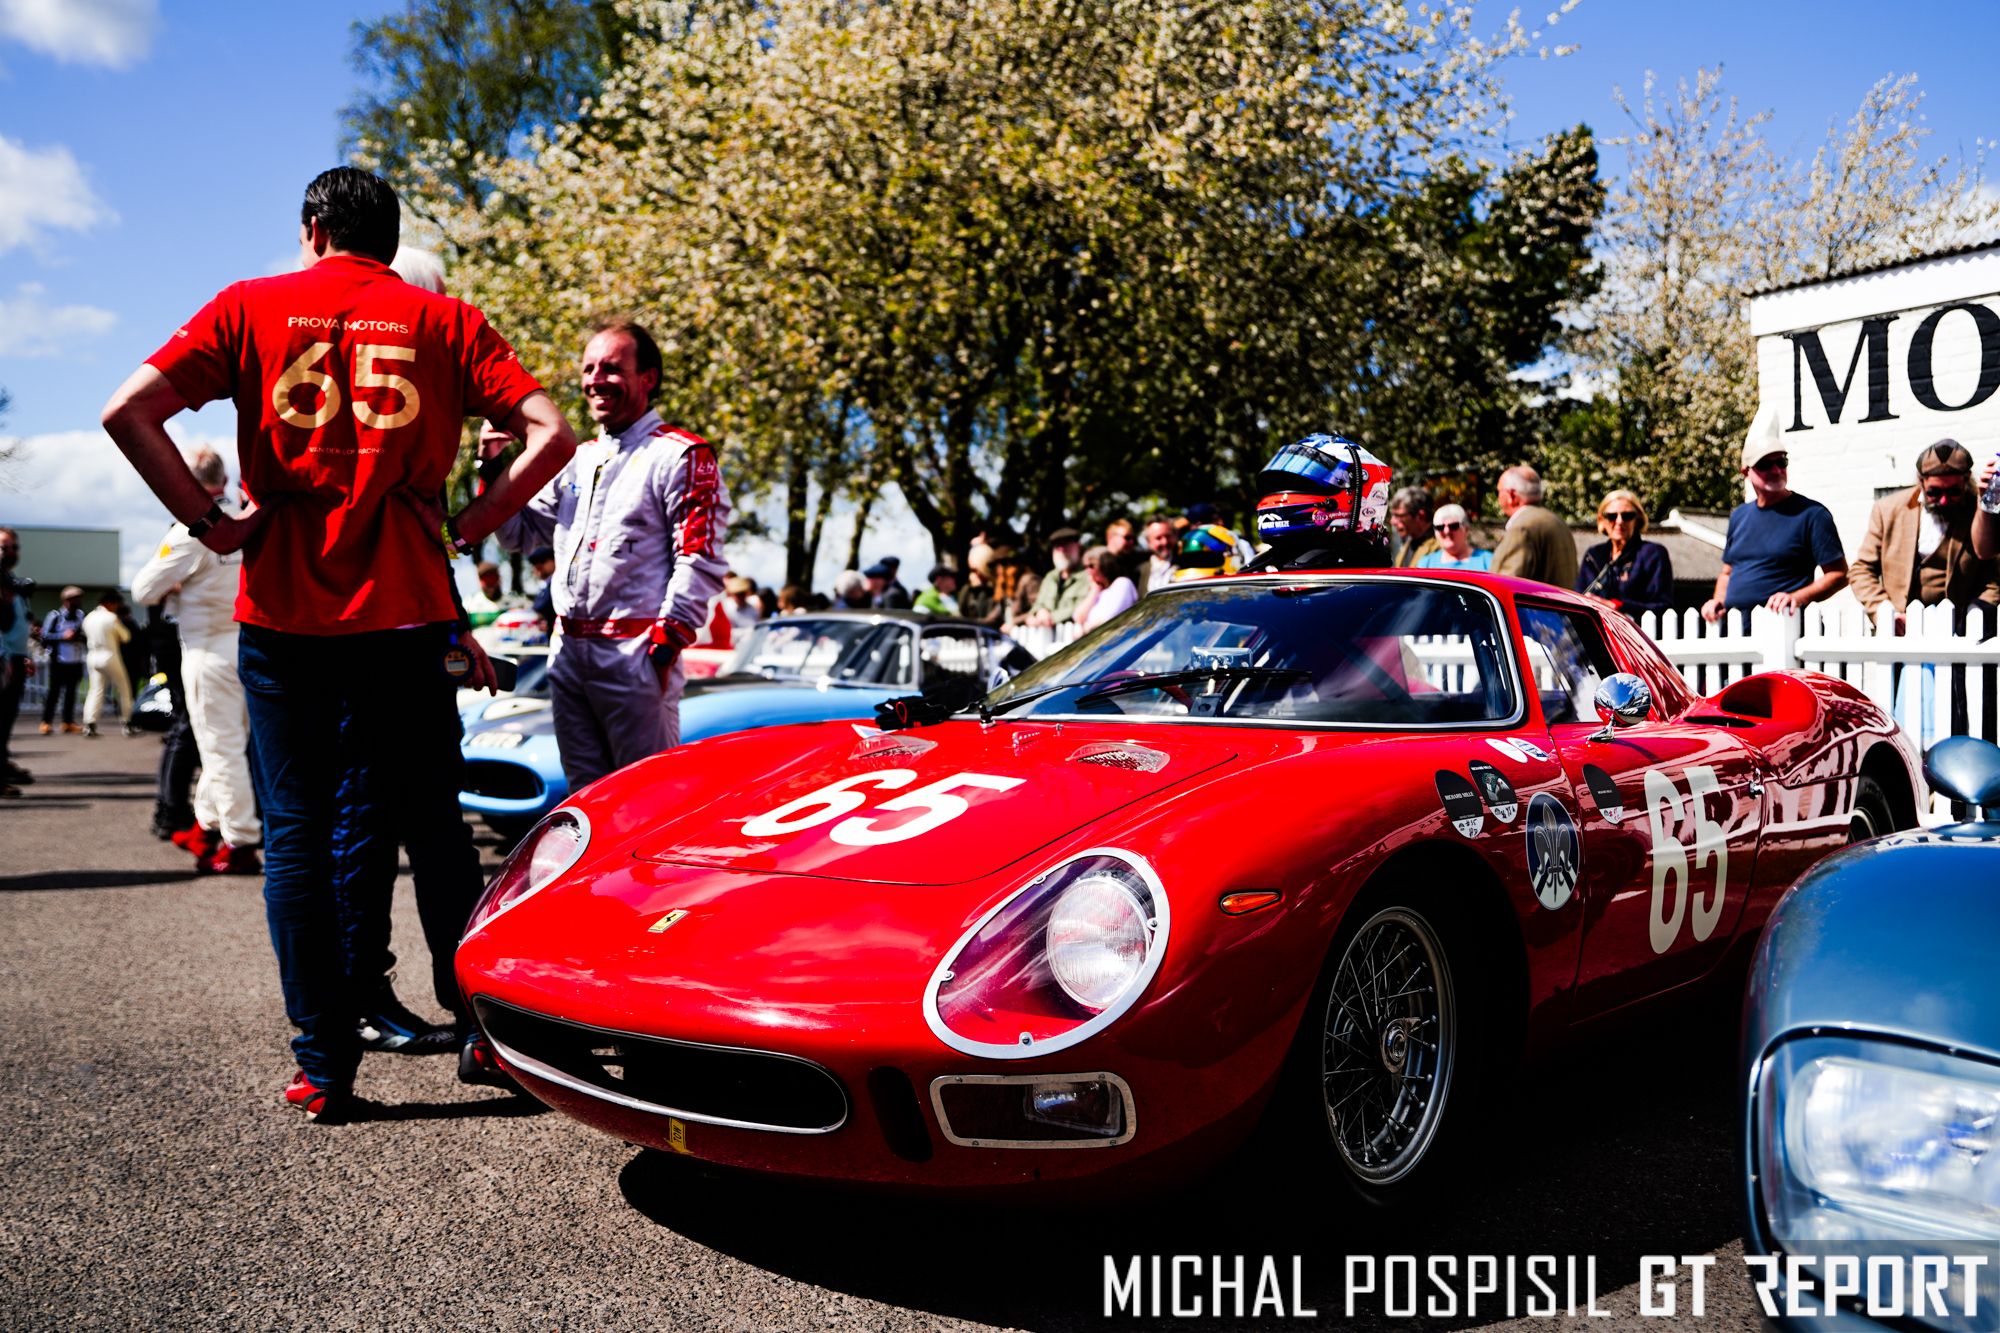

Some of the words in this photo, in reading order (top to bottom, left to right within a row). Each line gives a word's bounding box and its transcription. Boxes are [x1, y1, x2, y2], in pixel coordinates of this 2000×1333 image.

[288, 317, 340, 329] PROVA
[344, 320, 409, 334] MOTORS
[273, 342, 420, 429] 65
[1784, 302, 2000, 432] MO
[741, 769, 1027, 846] 65
[1444, 793, 1463, 801] RICHARD
[1463, 791, 1475, 799] MILLE
[1644, 765, 1728, 955] 65
[673, 1124, 682, 1143] TOW
